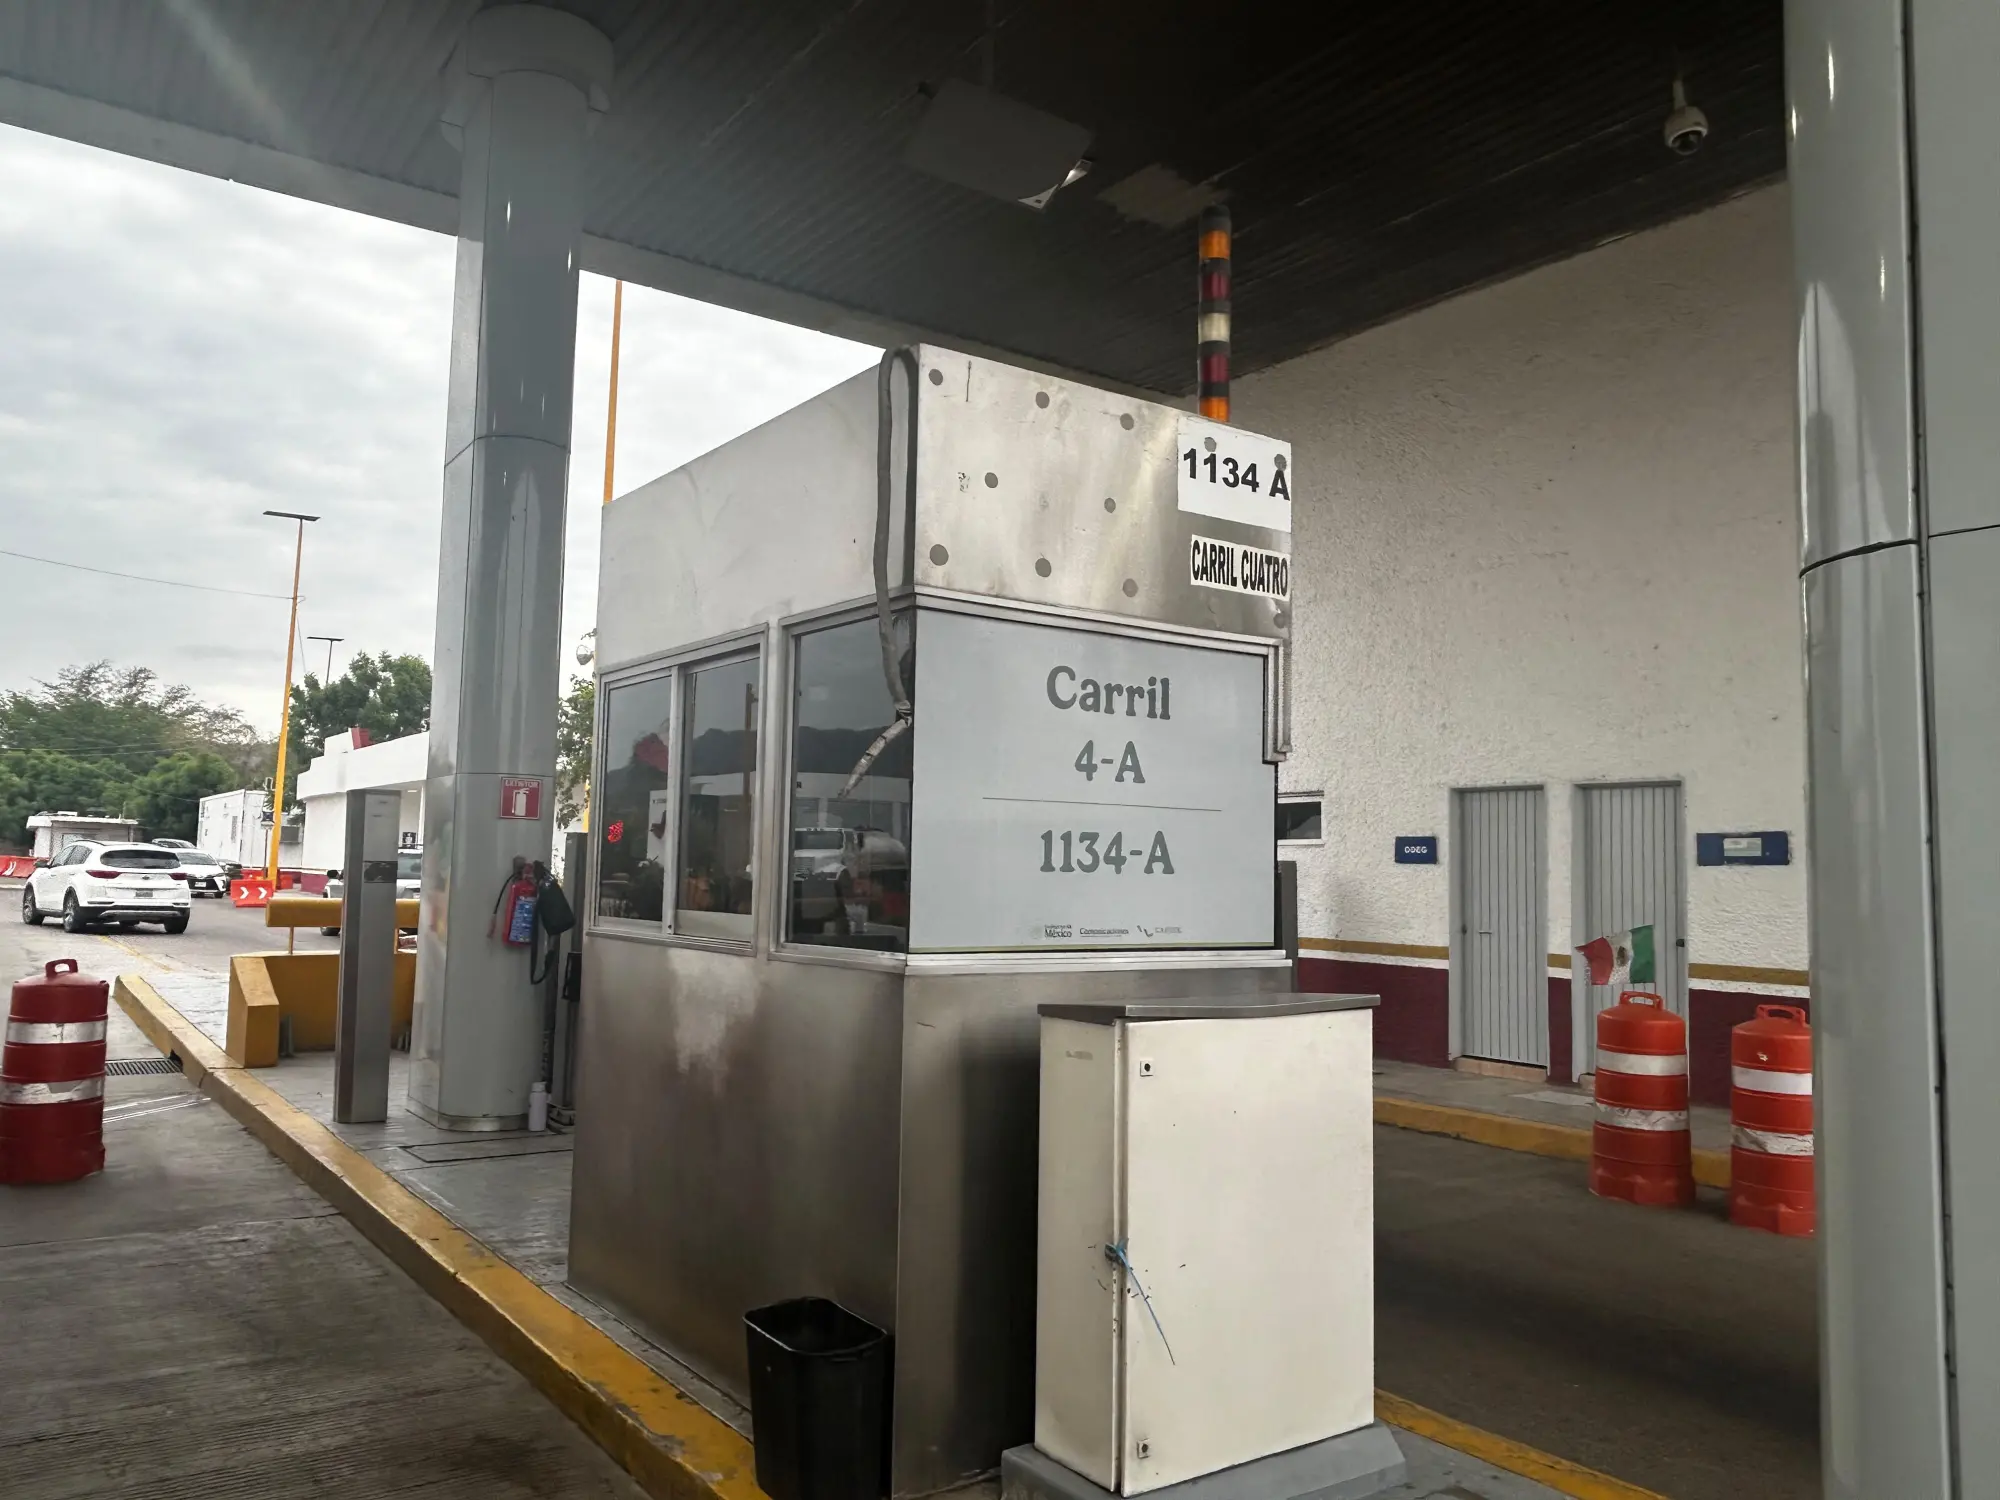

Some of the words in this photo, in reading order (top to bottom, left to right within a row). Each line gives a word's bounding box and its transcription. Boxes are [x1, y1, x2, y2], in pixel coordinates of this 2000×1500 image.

[1183, 447, 1260, 493] 1134
[1269, 469, 1291, 501] A
[1191, 539, 1238, 587] CARRIL
[1241, 549, 1289, 597] CUATRO
[1046, 665, 1171, 720] Carril
[1074, 739, 1146, 784] 4-A
[1039, 829, 1175, 875] 1134-A
